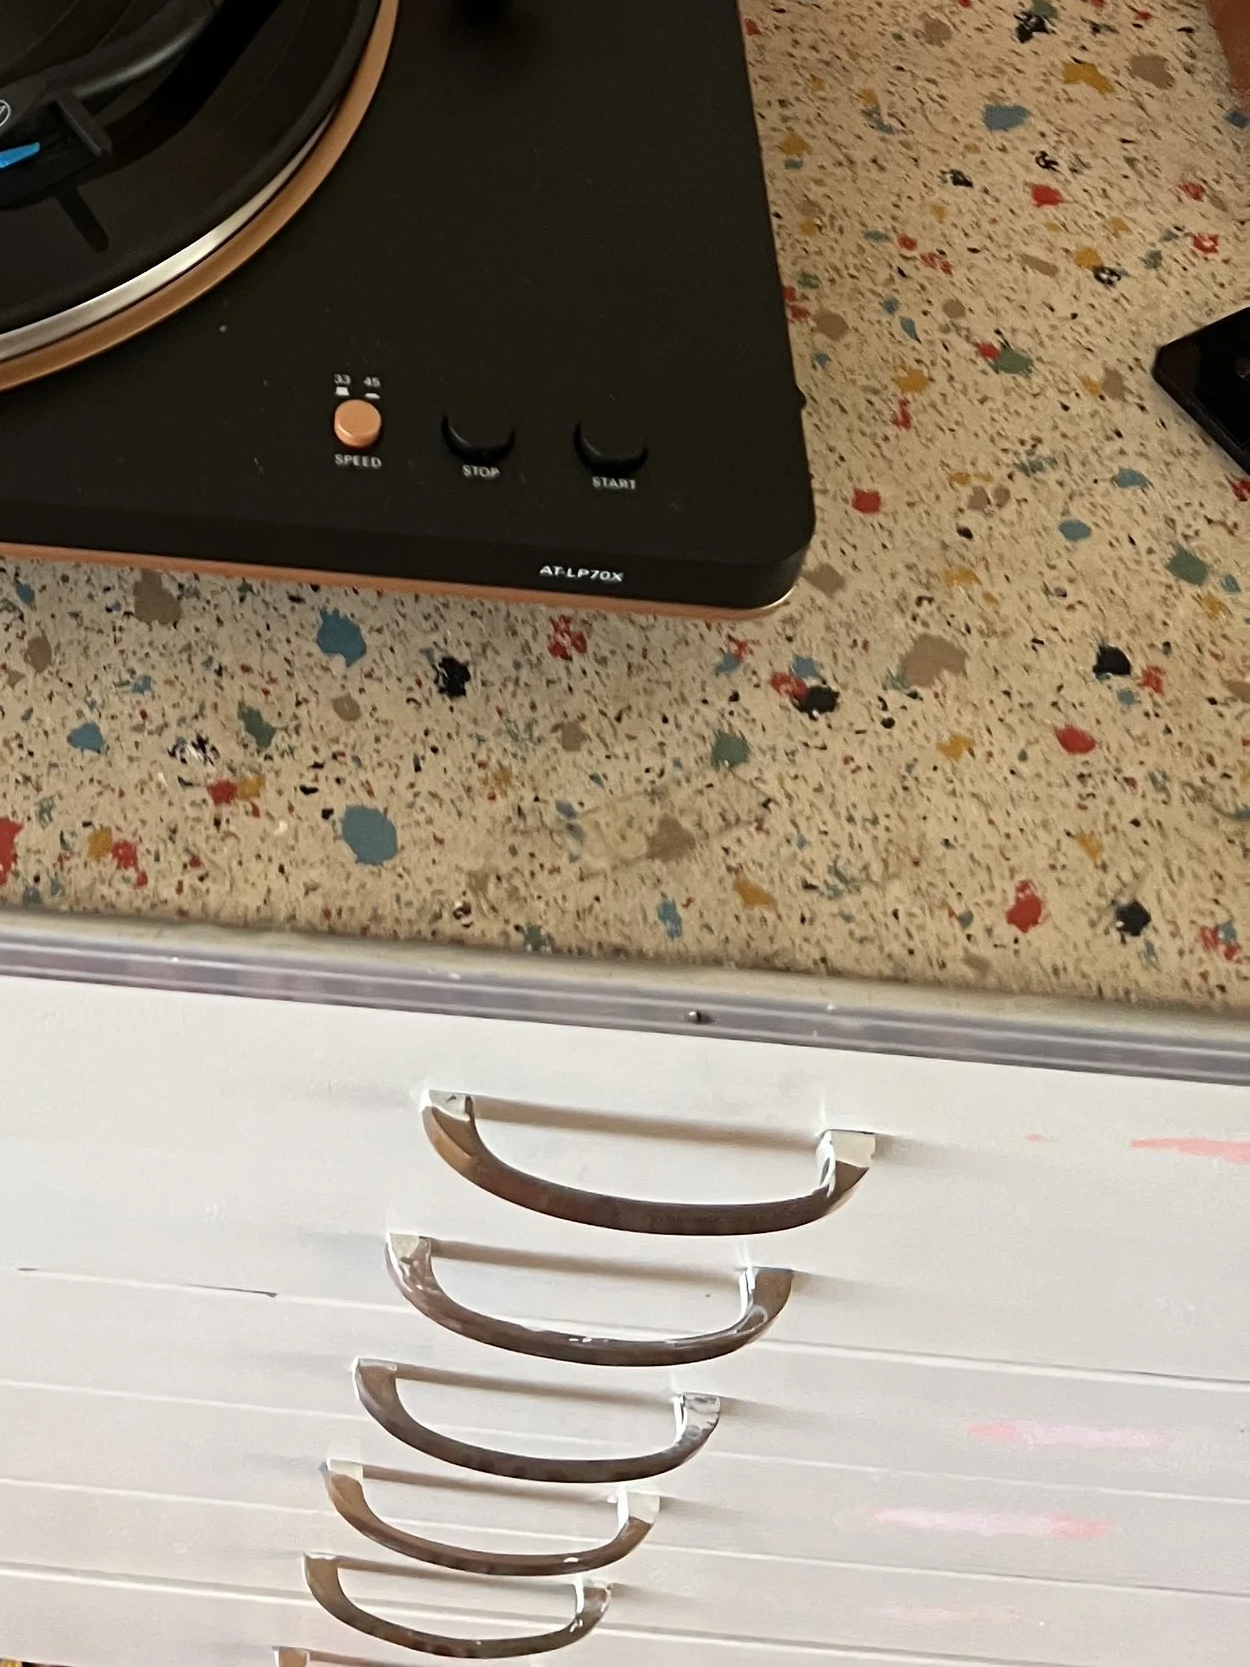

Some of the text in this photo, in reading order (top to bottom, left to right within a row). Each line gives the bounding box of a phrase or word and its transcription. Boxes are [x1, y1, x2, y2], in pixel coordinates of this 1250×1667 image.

[334, 373, 381, 388] 33 45
[334, 453, 383, 469] SPEED
[461, 464, 501, 479] STOP
[591, 476, 637, 490] START
[539, 565, 624, 582] AT-LP70X
